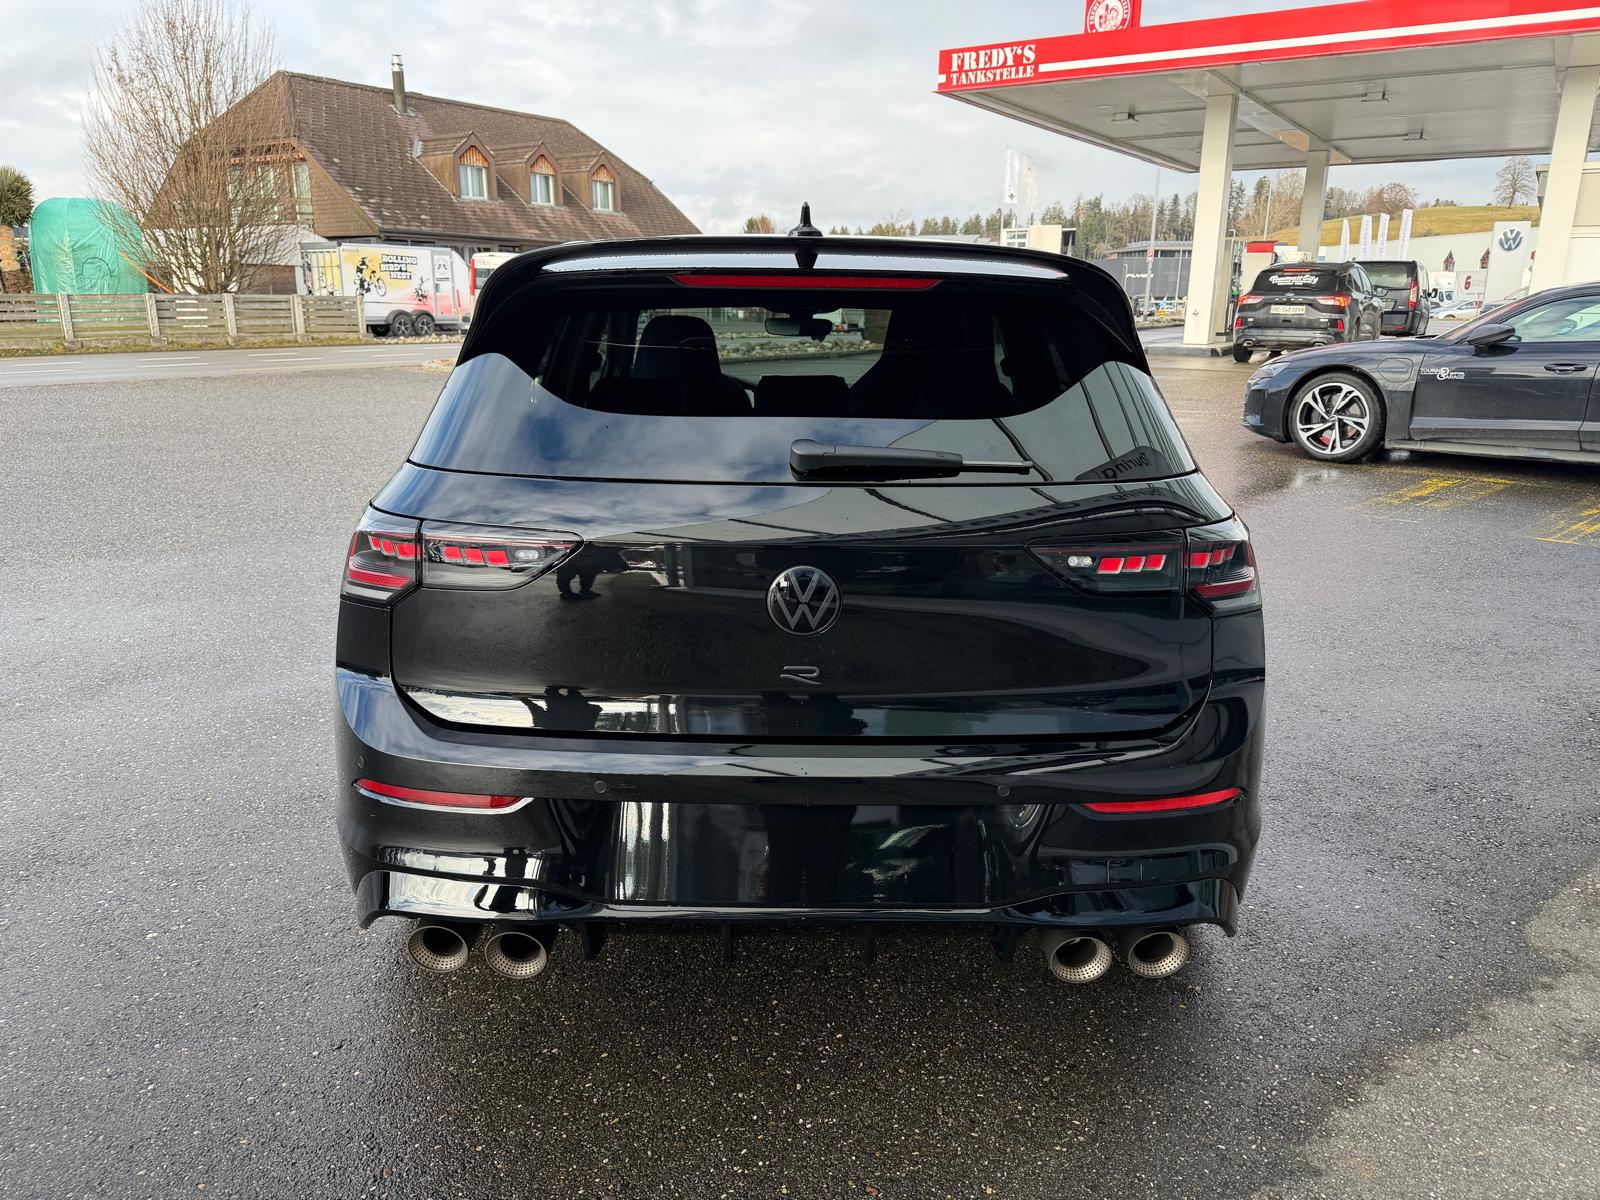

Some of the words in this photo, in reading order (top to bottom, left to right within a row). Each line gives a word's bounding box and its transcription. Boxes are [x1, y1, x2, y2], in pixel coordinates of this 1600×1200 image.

[950, 44, 1036, 72] FREDY'S
[950, 64, 1035, 86] TANKSTELLE
[382, 255, 417, 265] ROLLING
[779, 665, 823, 685] R
